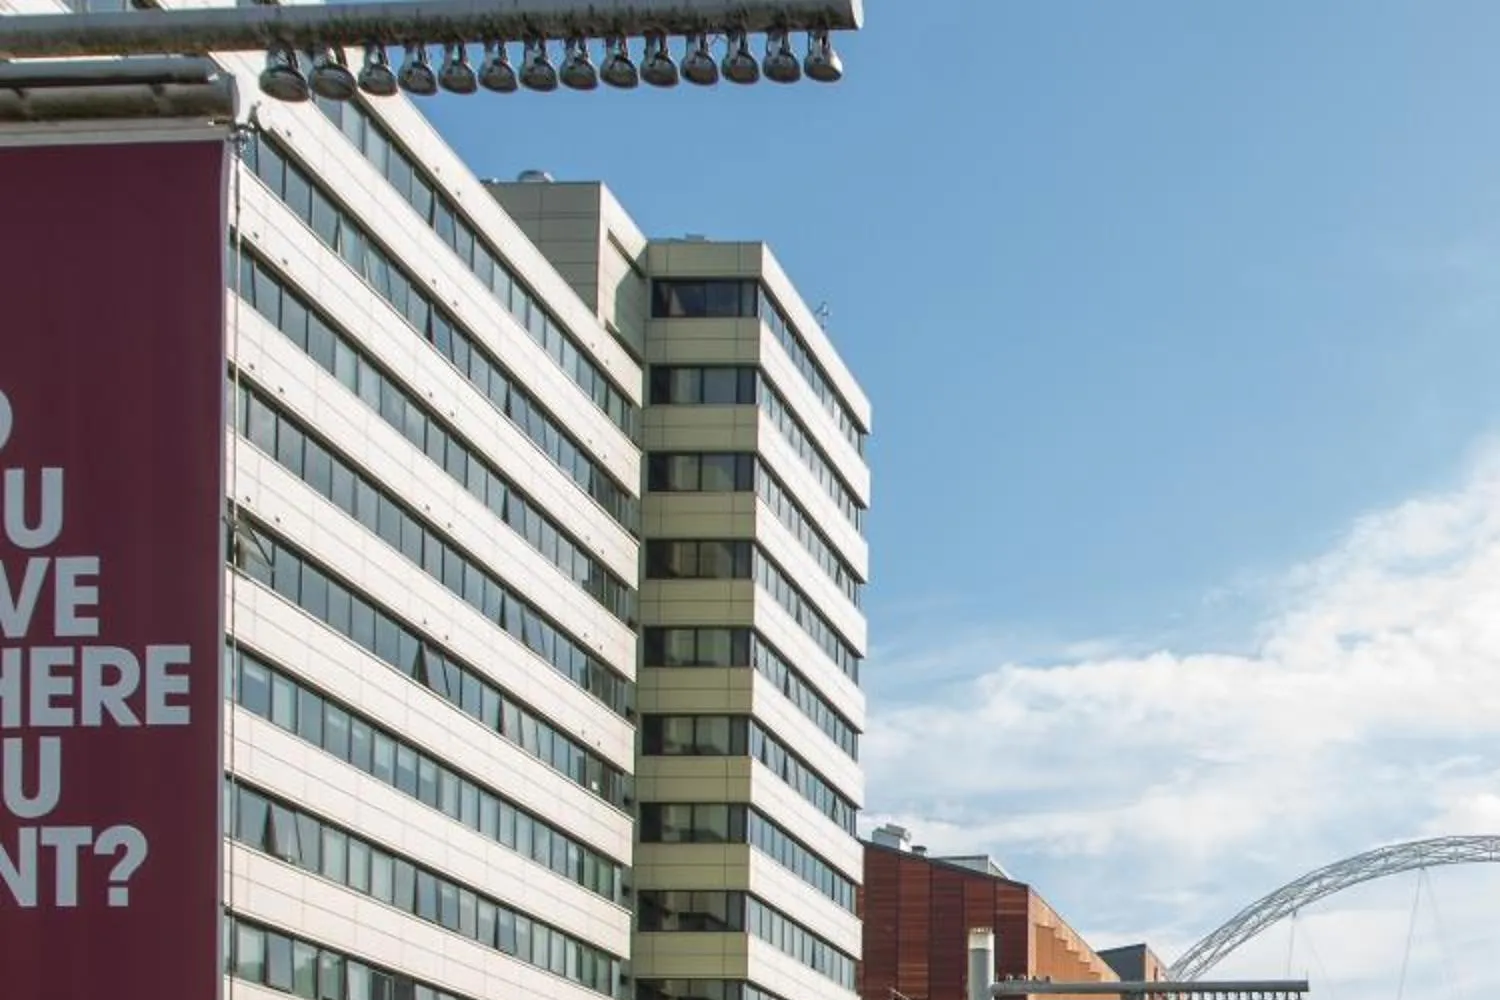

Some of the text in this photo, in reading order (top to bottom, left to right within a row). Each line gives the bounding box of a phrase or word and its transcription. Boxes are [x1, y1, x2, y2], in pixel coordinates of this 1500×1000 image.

[4, 467, 64, 549] U
[0, 556, 100, 638] VE
[0, 645, 191, 727] ERE
[3, 736, 61, 819] U
[0, 825, 148, 907] NT?
